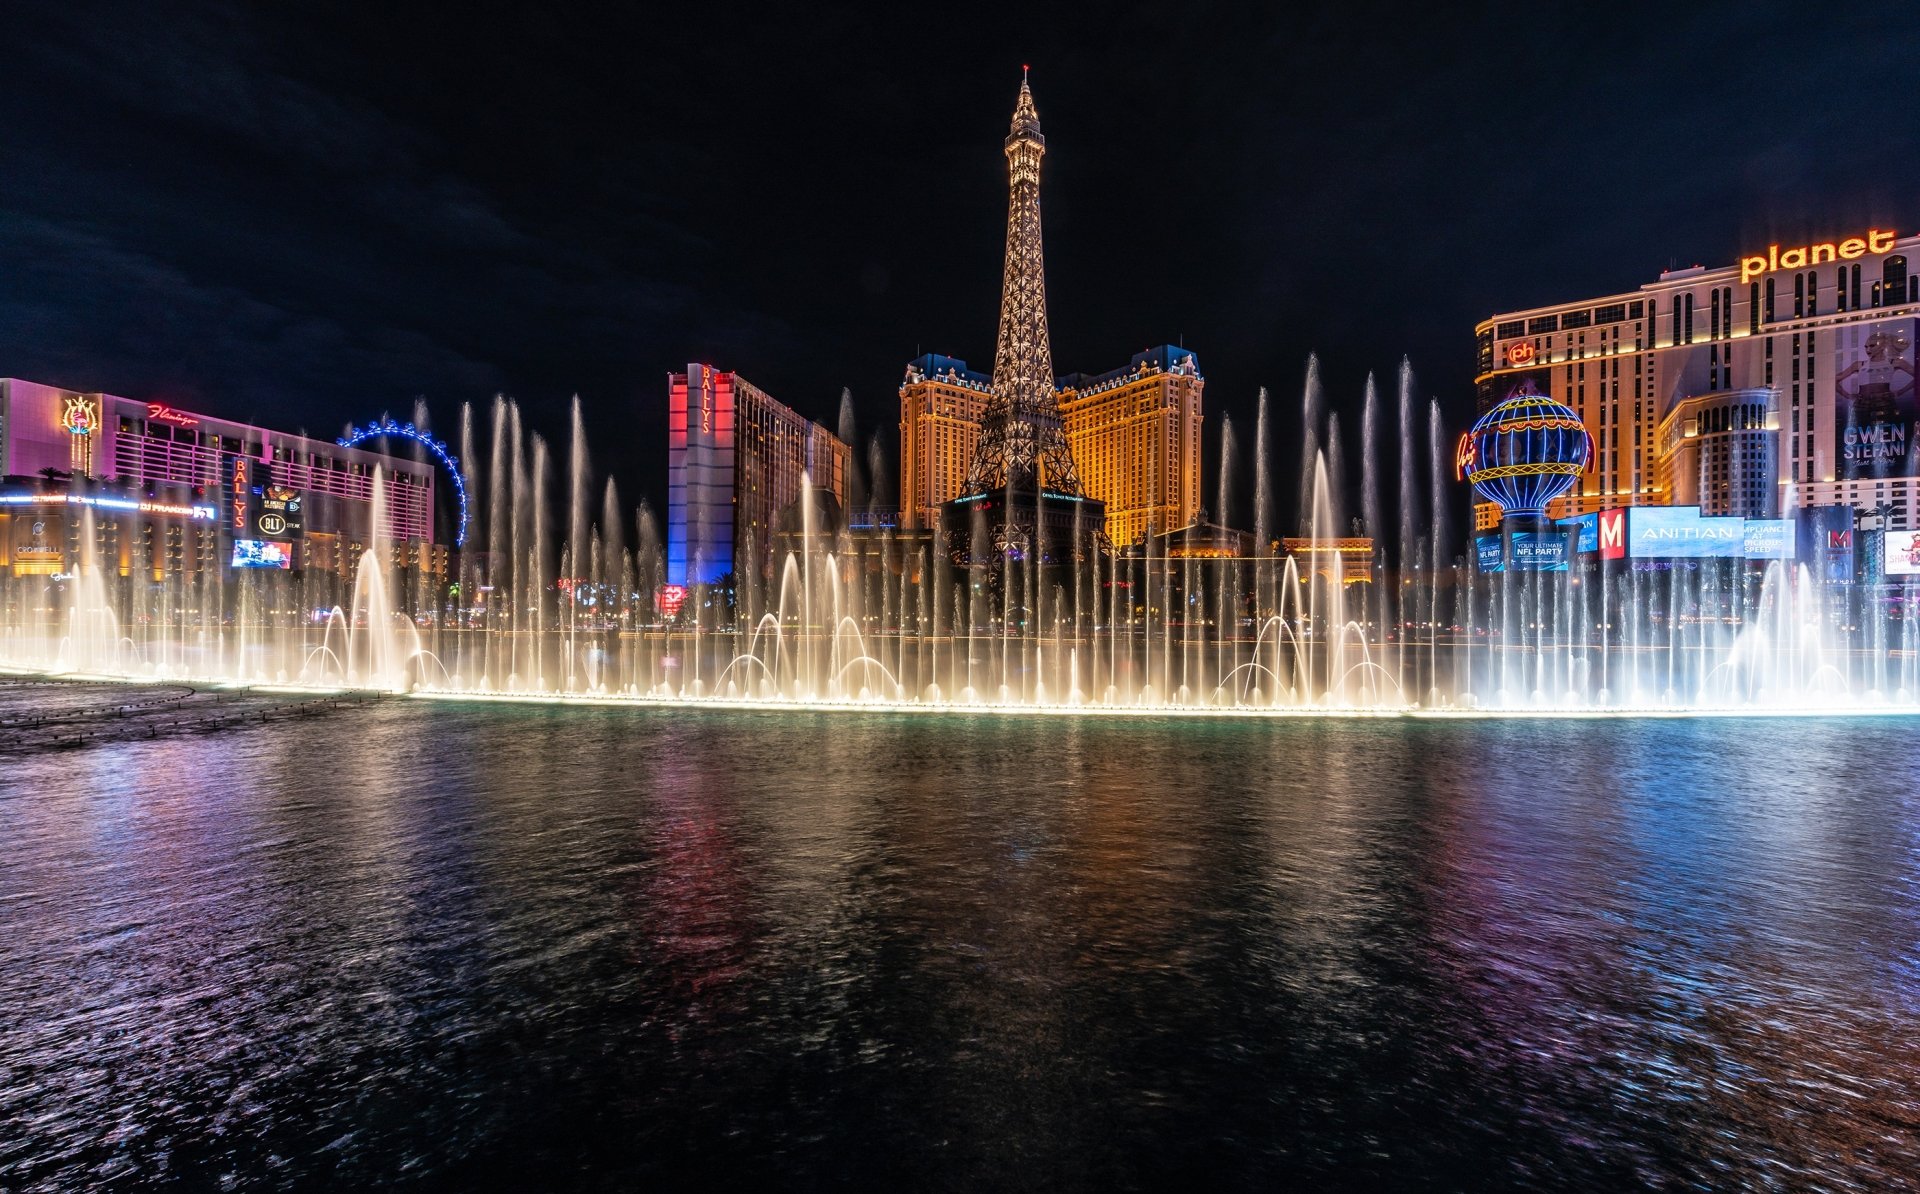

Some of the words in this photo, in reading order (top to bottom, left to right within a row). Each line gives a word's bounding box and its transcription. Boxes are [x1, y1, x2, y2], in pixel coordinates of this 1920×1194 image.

[1741, 229, 1896, 284] planet
[1512, 343, 1534, 361] ph
[147, 404, 199, 426] Flamingo
[1843, 423, 1905, 445] GWEN
[1843, 441, 1905, 459] STEFANI
[264, 517, 281, 530] BLT
[1642, 527, 1733, 539] ANITIAN
[1517, 548, 1533, 556] NFL
[1535, 548, 1563, 556] PARTY
